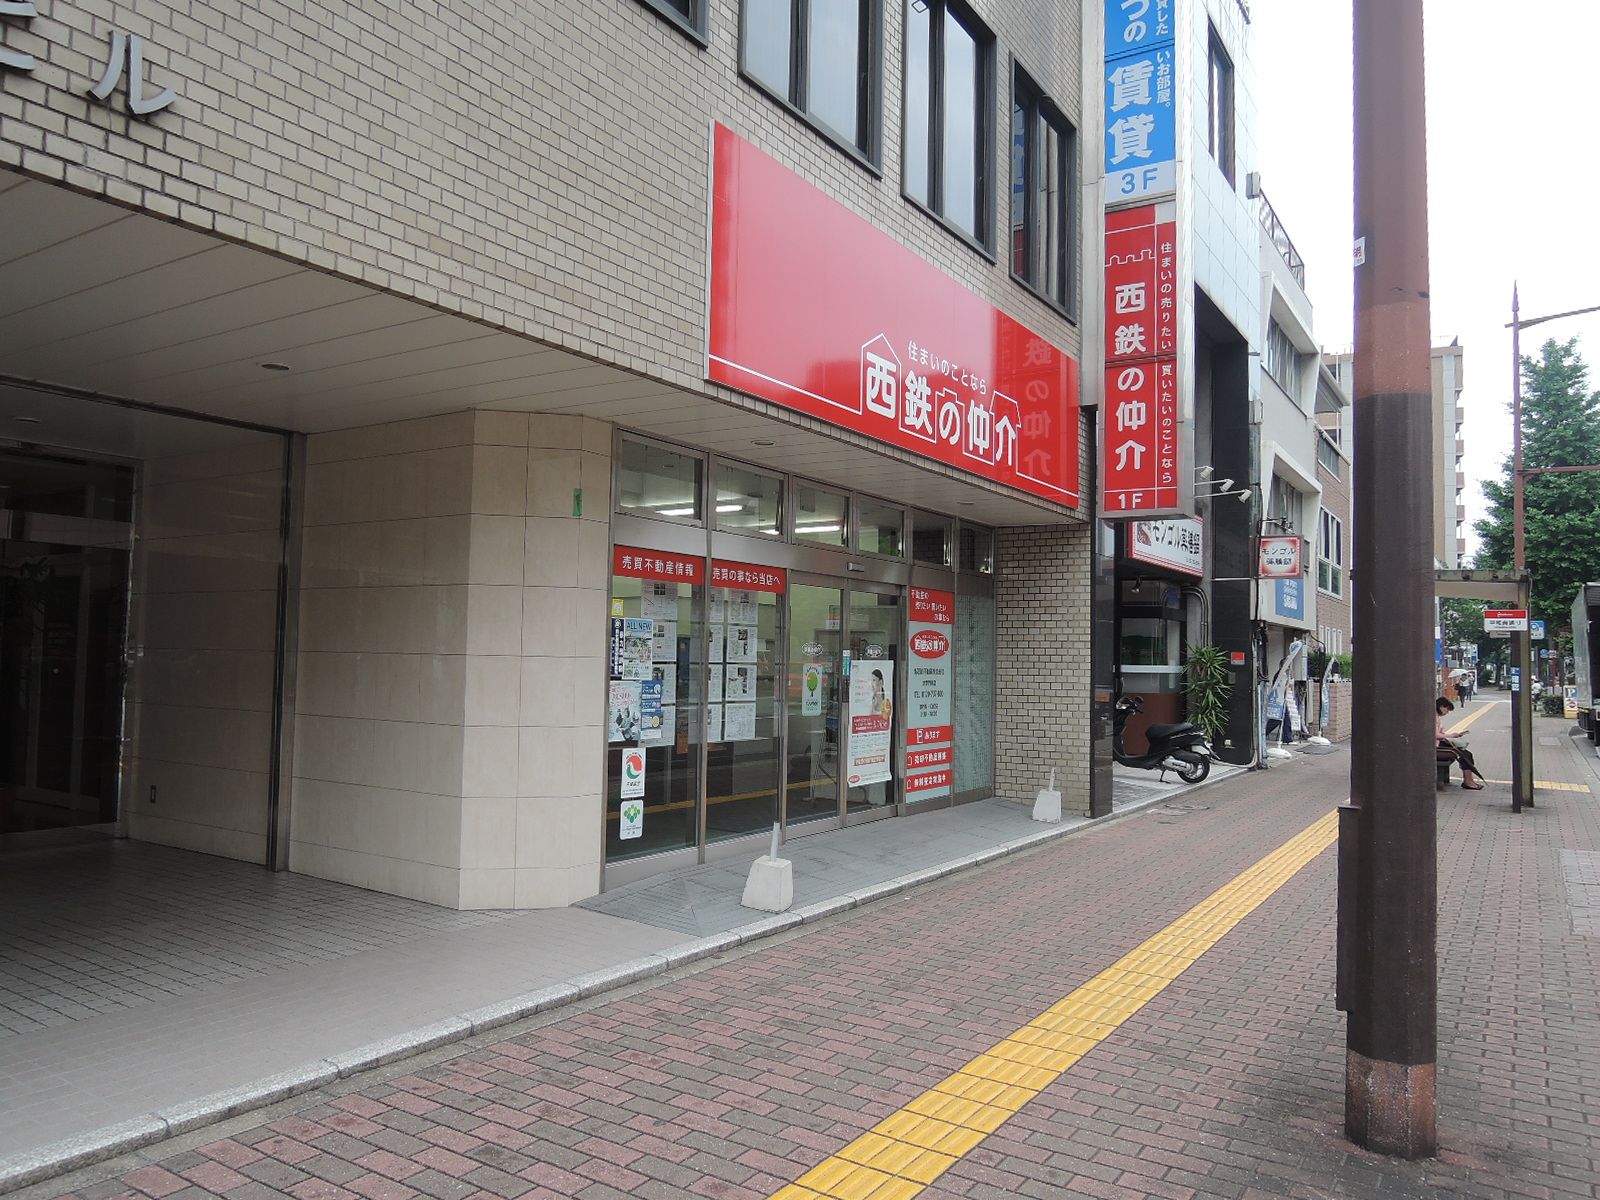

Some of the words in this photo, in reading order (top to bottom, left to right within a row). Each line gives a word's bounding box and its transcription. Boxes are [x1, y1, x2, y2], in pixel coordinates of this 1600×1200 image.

[1121, 167, 1158, 195] 3F
[908, 340, 988, 396] 住まいのことなら
[1114, 282, 1147, 472] 西鉄の仲介
[866, 351, 1017, 467] 西鉄の仲介
[1118, 493, 1144, 509] 1F
[622, 555, 695, 577] 売買不動産情報
[712, 567, 781, 586] 売買の事なら当店へ
